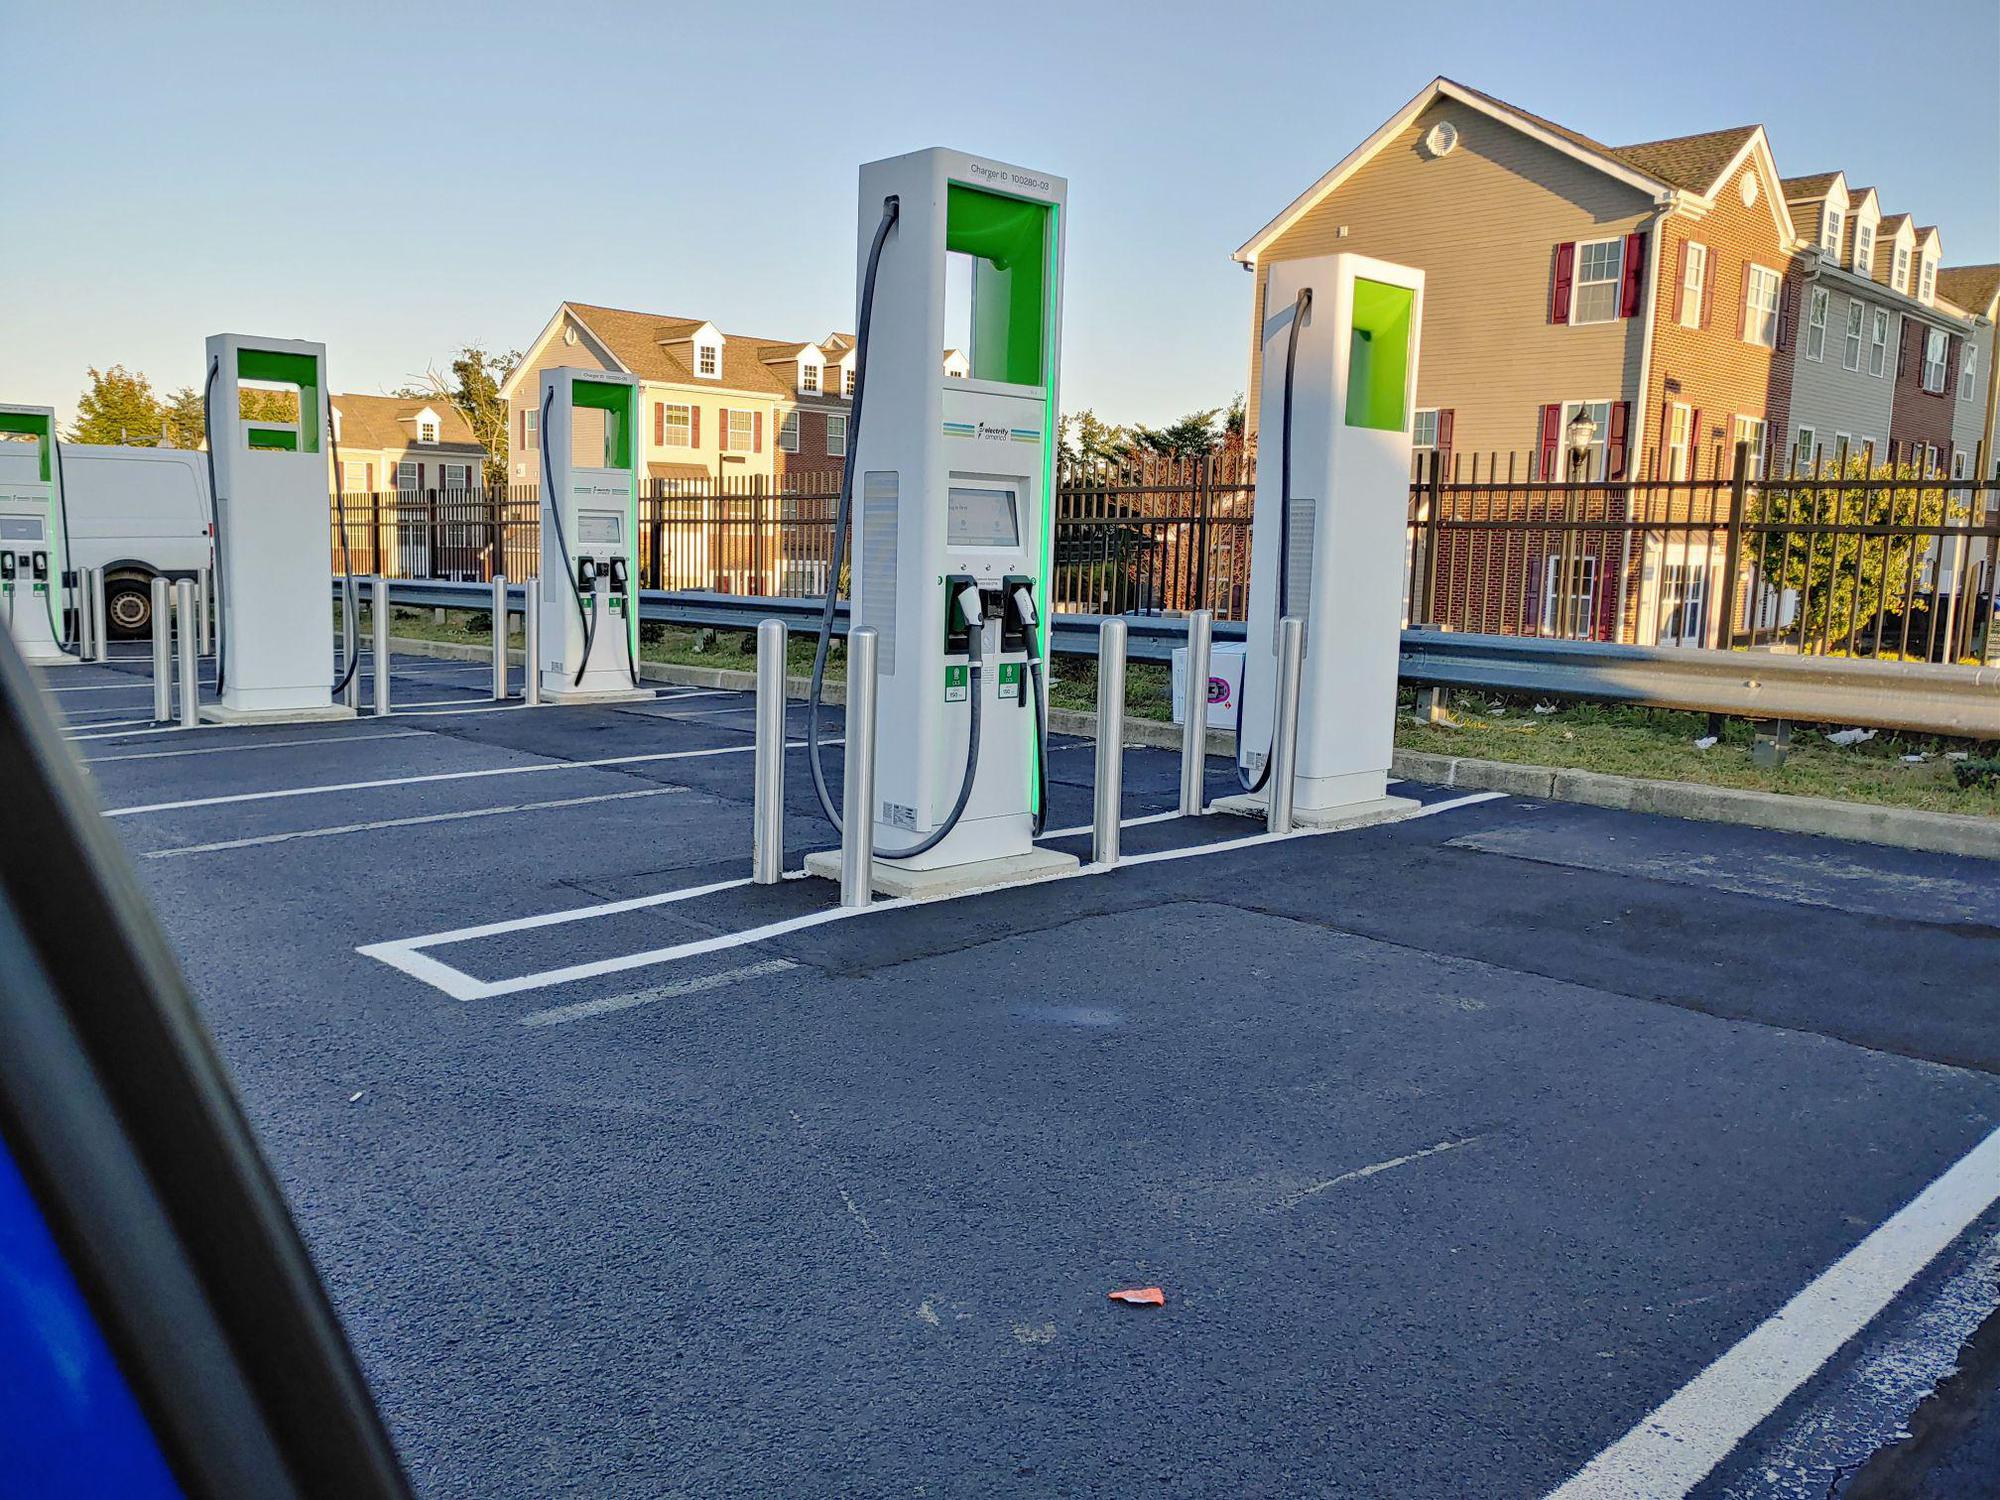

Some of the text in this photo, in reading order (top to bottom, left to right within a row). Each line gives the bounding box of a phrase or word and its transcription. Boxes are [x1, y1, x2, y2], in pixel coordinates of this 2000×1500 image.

[970, 163, 1050, 191] Charger ID 100280-03
[984, 426, 1009, 436] electrify
